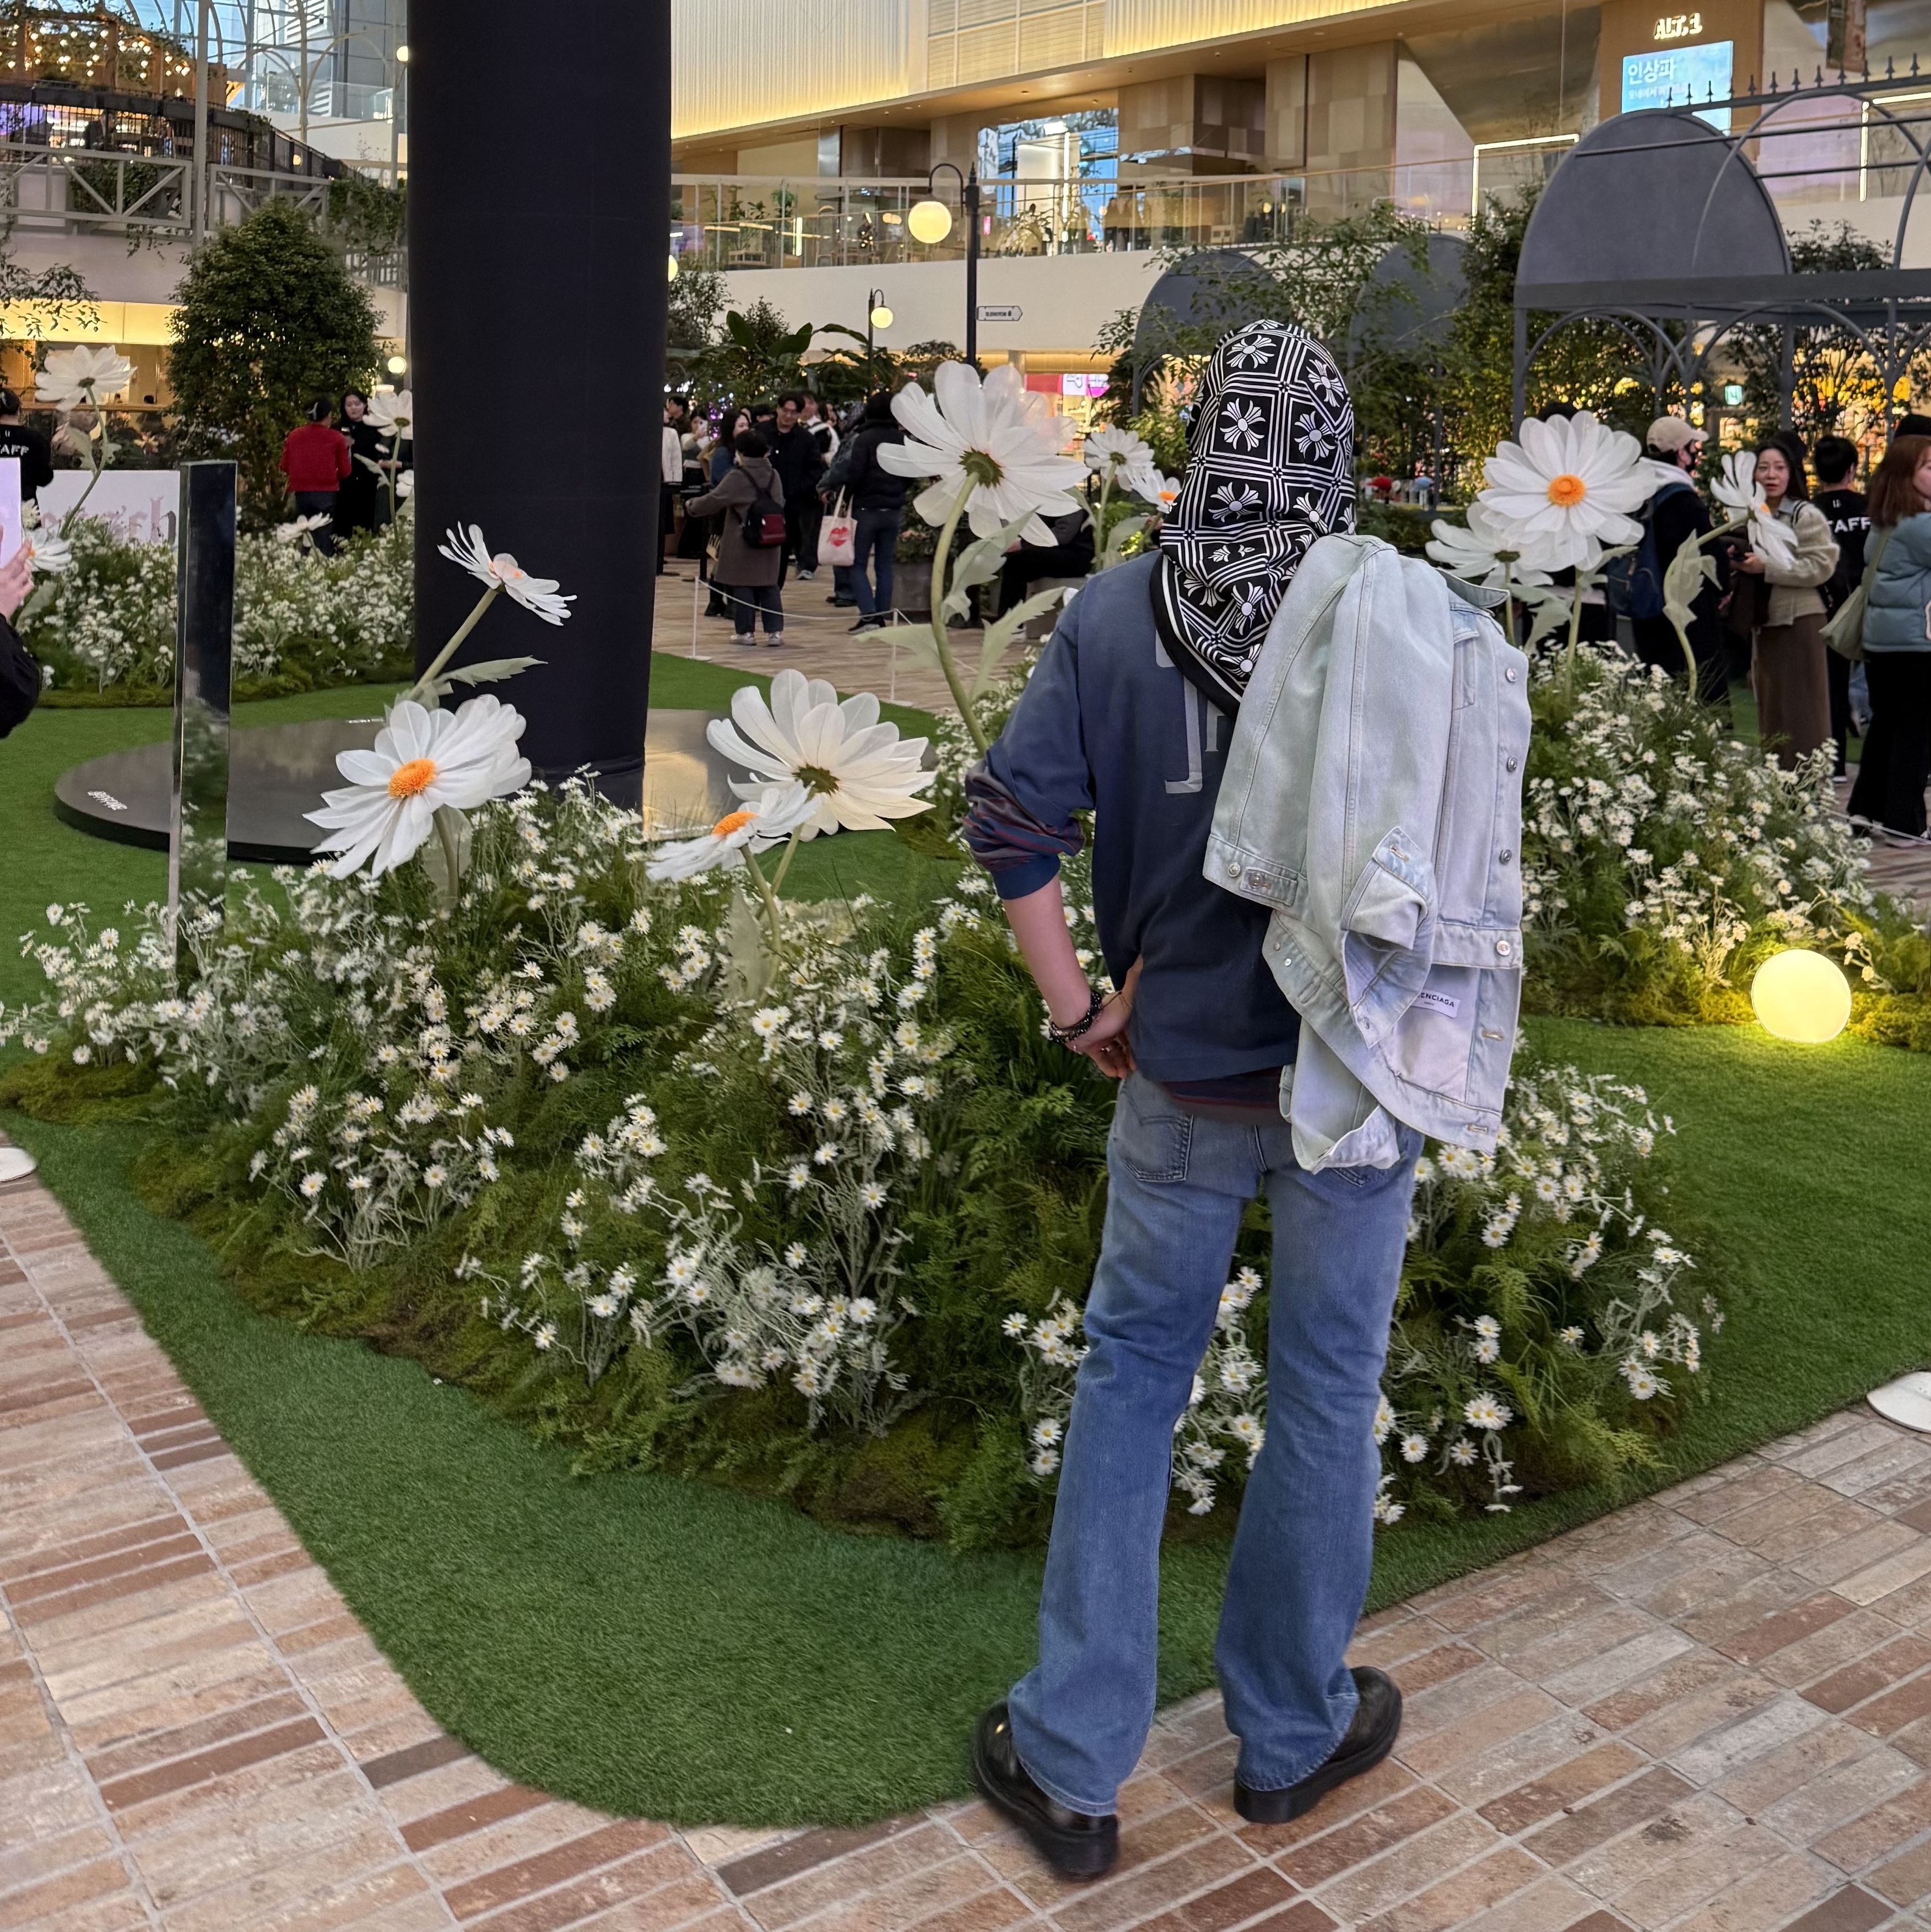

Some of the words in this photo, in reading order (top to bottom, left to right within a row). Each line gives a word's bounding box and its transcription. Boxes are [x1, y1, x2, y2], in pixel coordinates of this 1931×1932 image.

[1627, 56, 1676, 85] 인상파
[0, 443, 29, 456] AFF
[1418, 992, 1454, 1008] ENCIAGA
